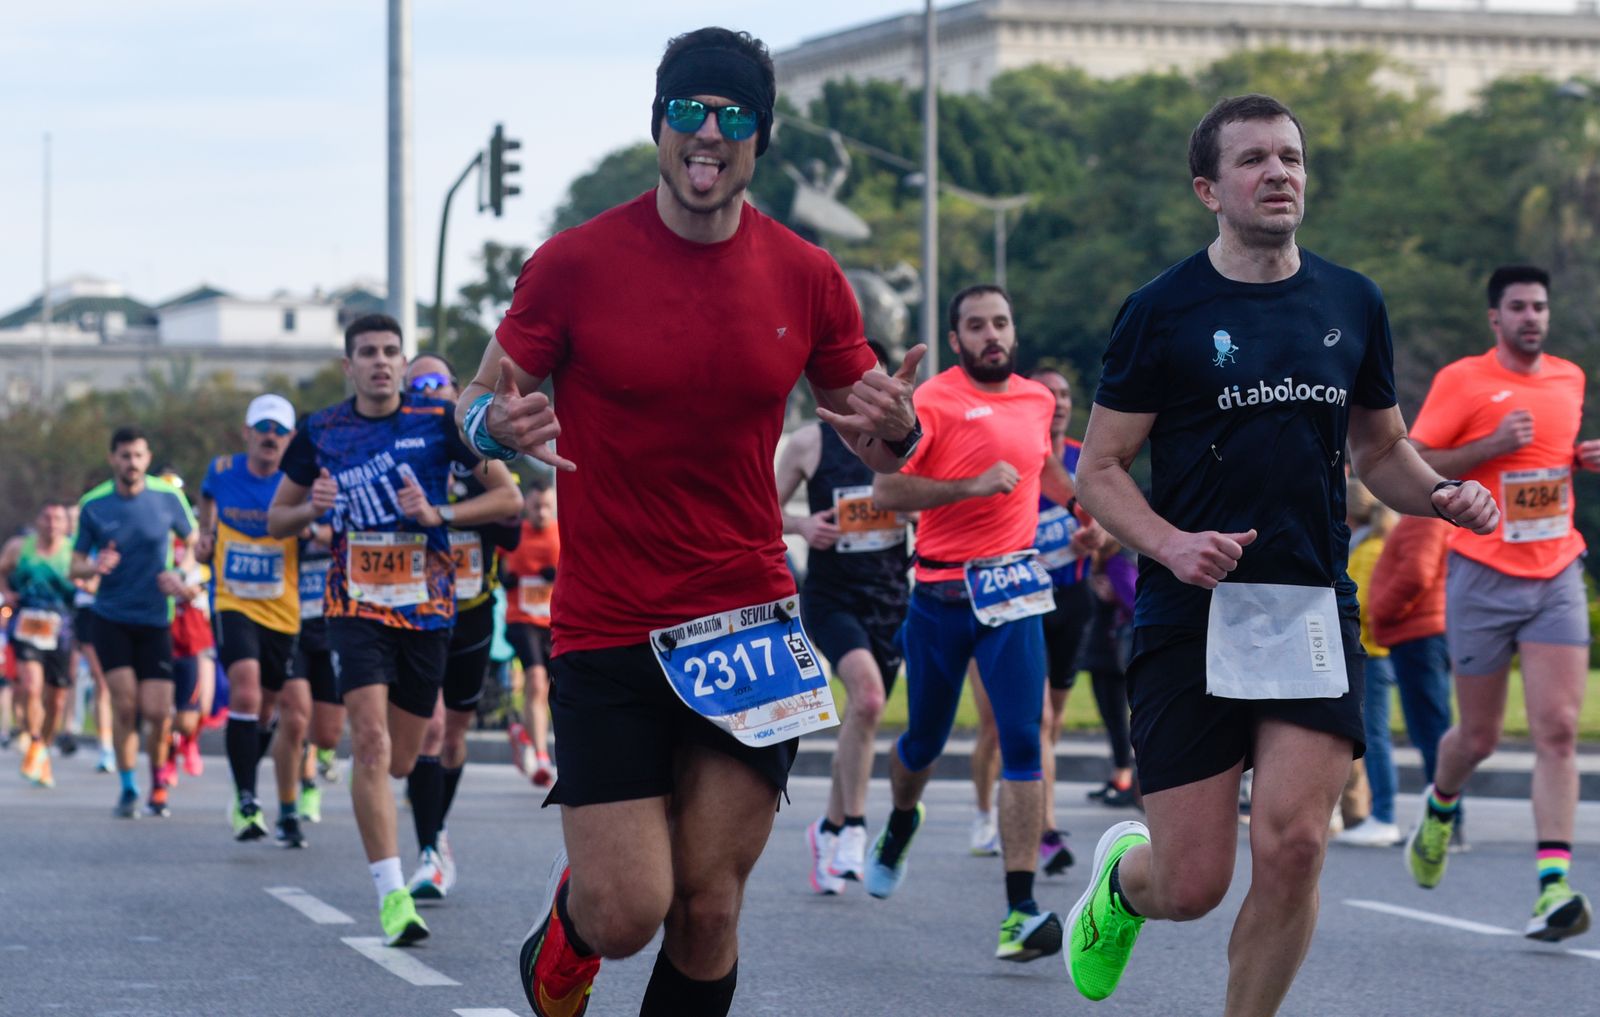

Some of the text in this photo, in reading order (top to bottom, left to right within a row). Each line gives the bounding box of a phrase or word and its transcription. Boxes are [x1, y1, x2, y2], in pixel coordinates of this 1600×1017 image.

[1217, 377, 1347, 411] diabolocom
[1515, 485, 1560, 508] 4284
[360, 550, 405, 573] 3741
[979, 562, 1032, 595] 2644
[686, 615, 722, 639] MARATÓN
[684, 637, 776, 698] 2317
[754, 728, 775, 741] HOKA
